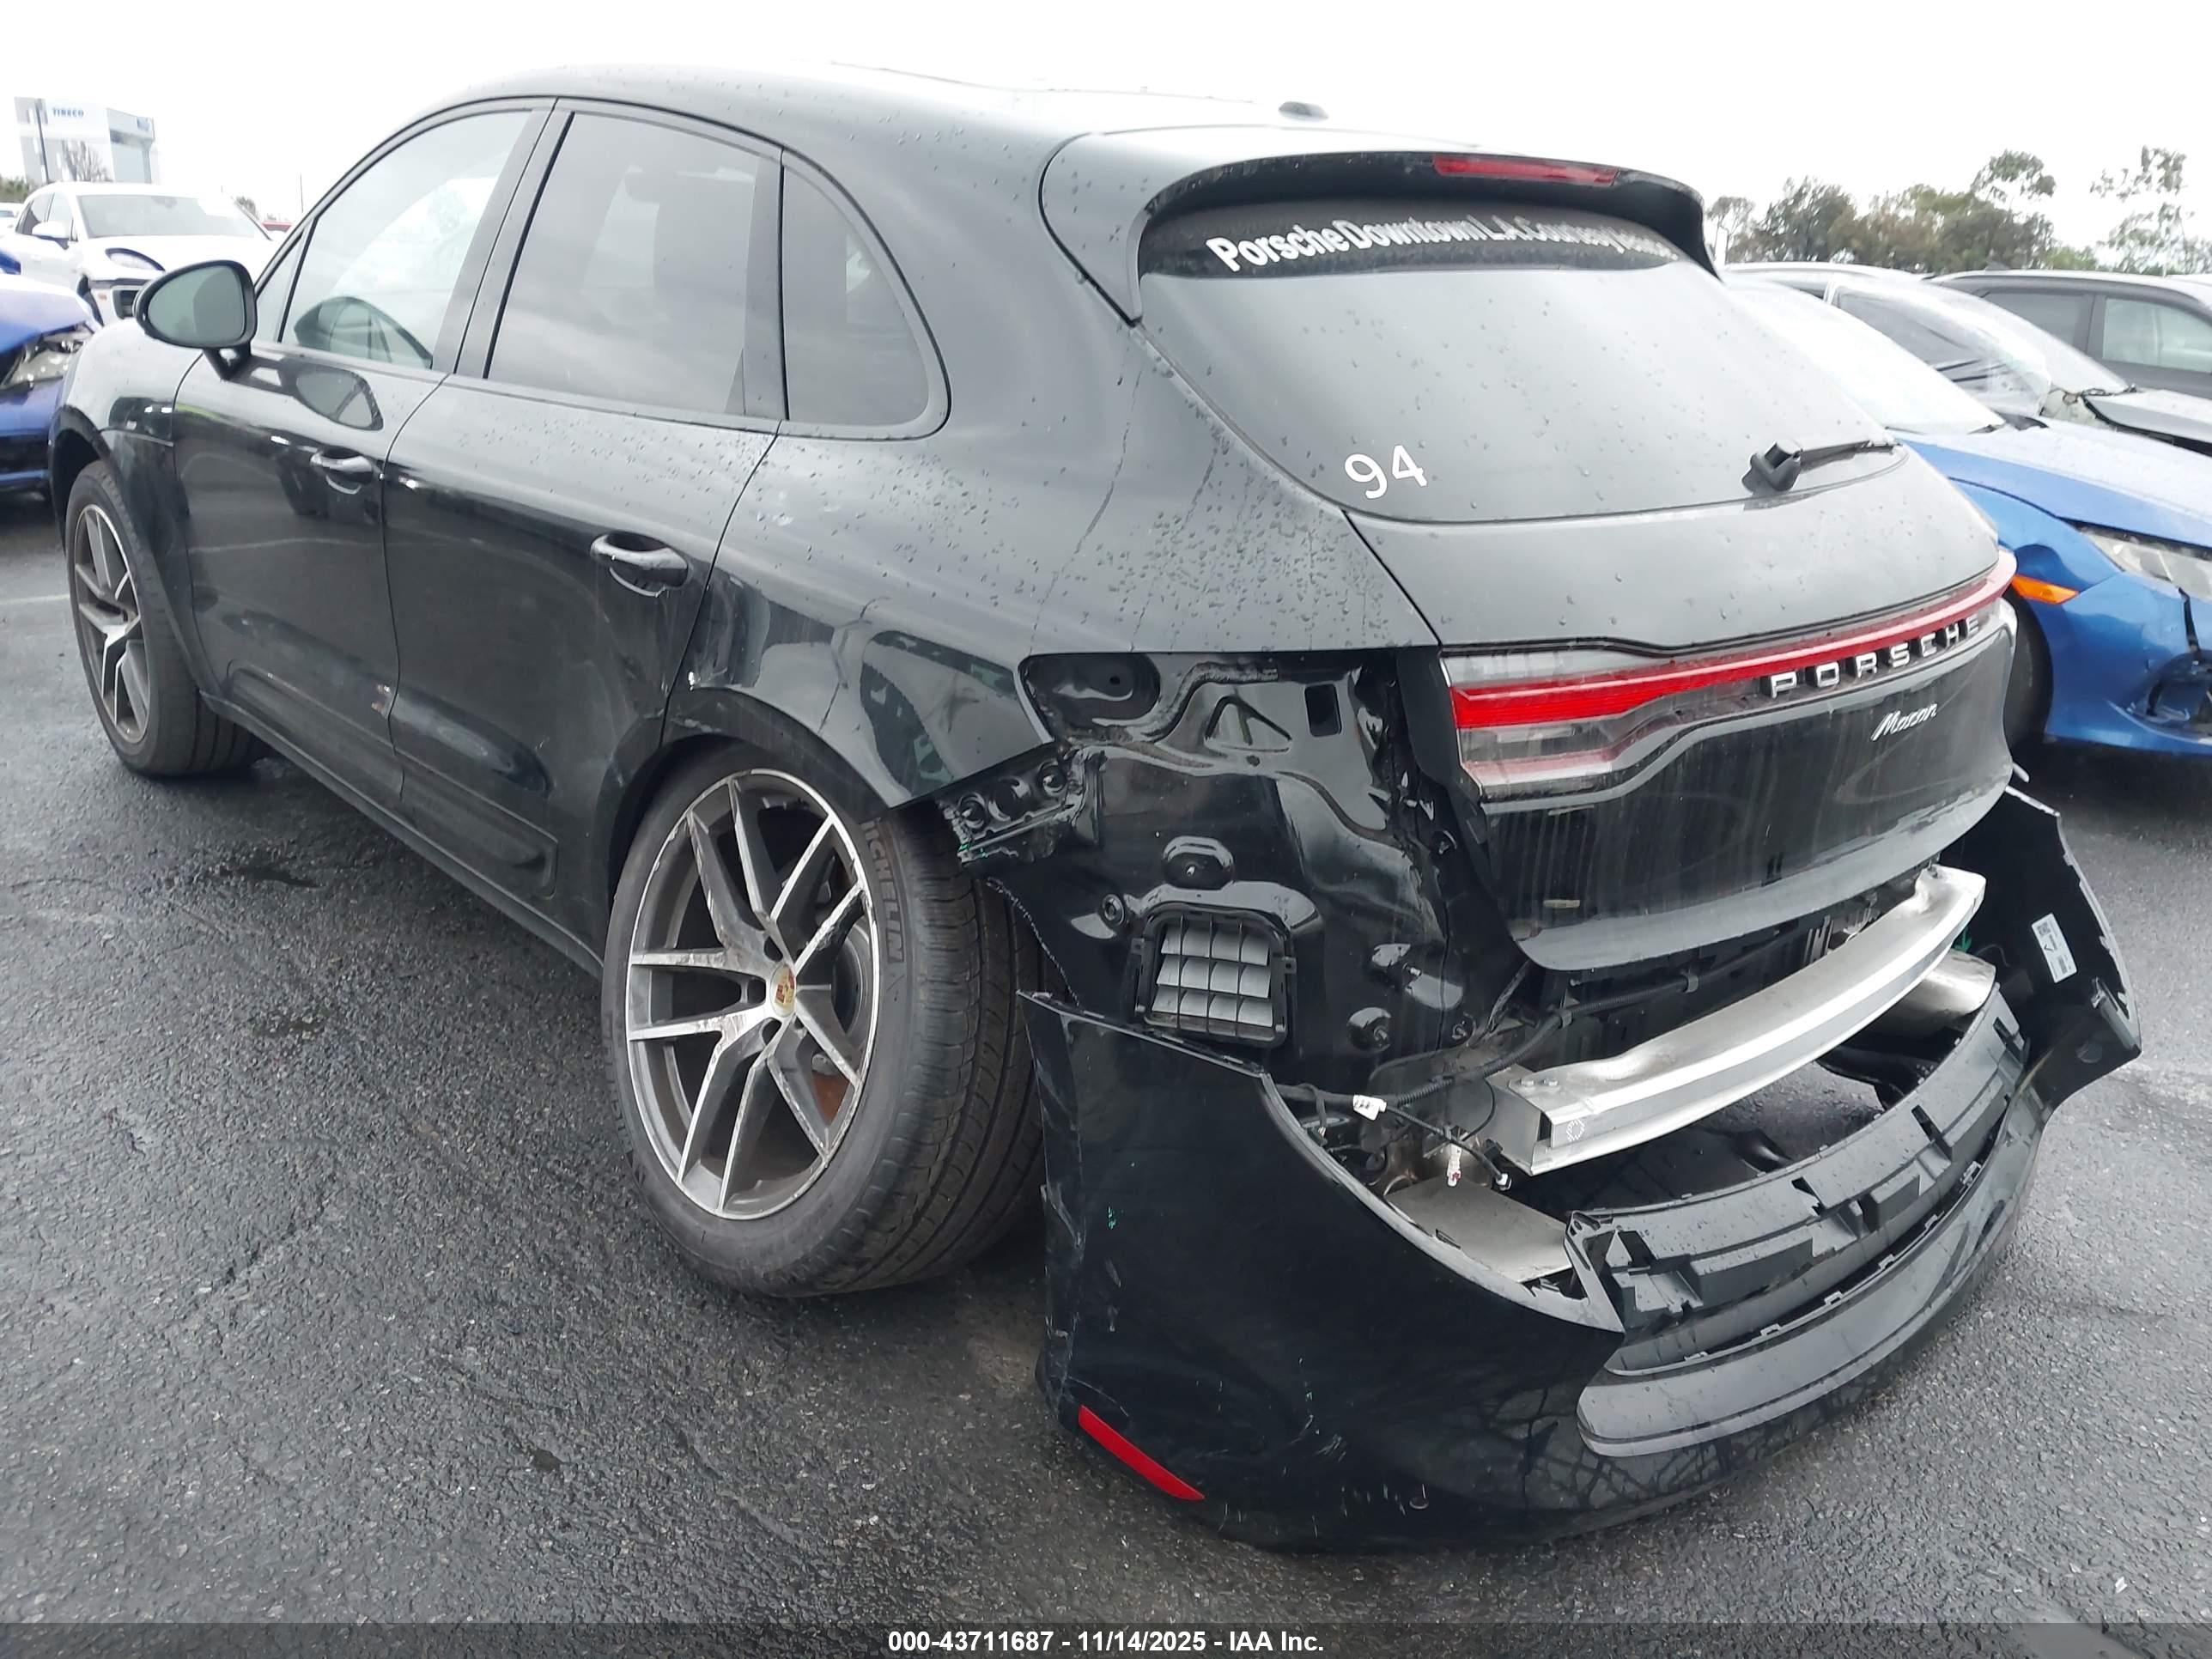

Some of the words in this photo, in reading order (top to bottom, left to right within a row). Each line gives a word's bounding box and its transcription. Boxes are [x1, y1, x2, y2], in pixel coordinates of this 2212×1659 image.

[1206, 224, 1351, 272] Porsche
[1345, 445, 1428, 499] 94
[1770, 614, 1980, 699] PORSCHE
[1870, 703, 1938, 742] Macan
